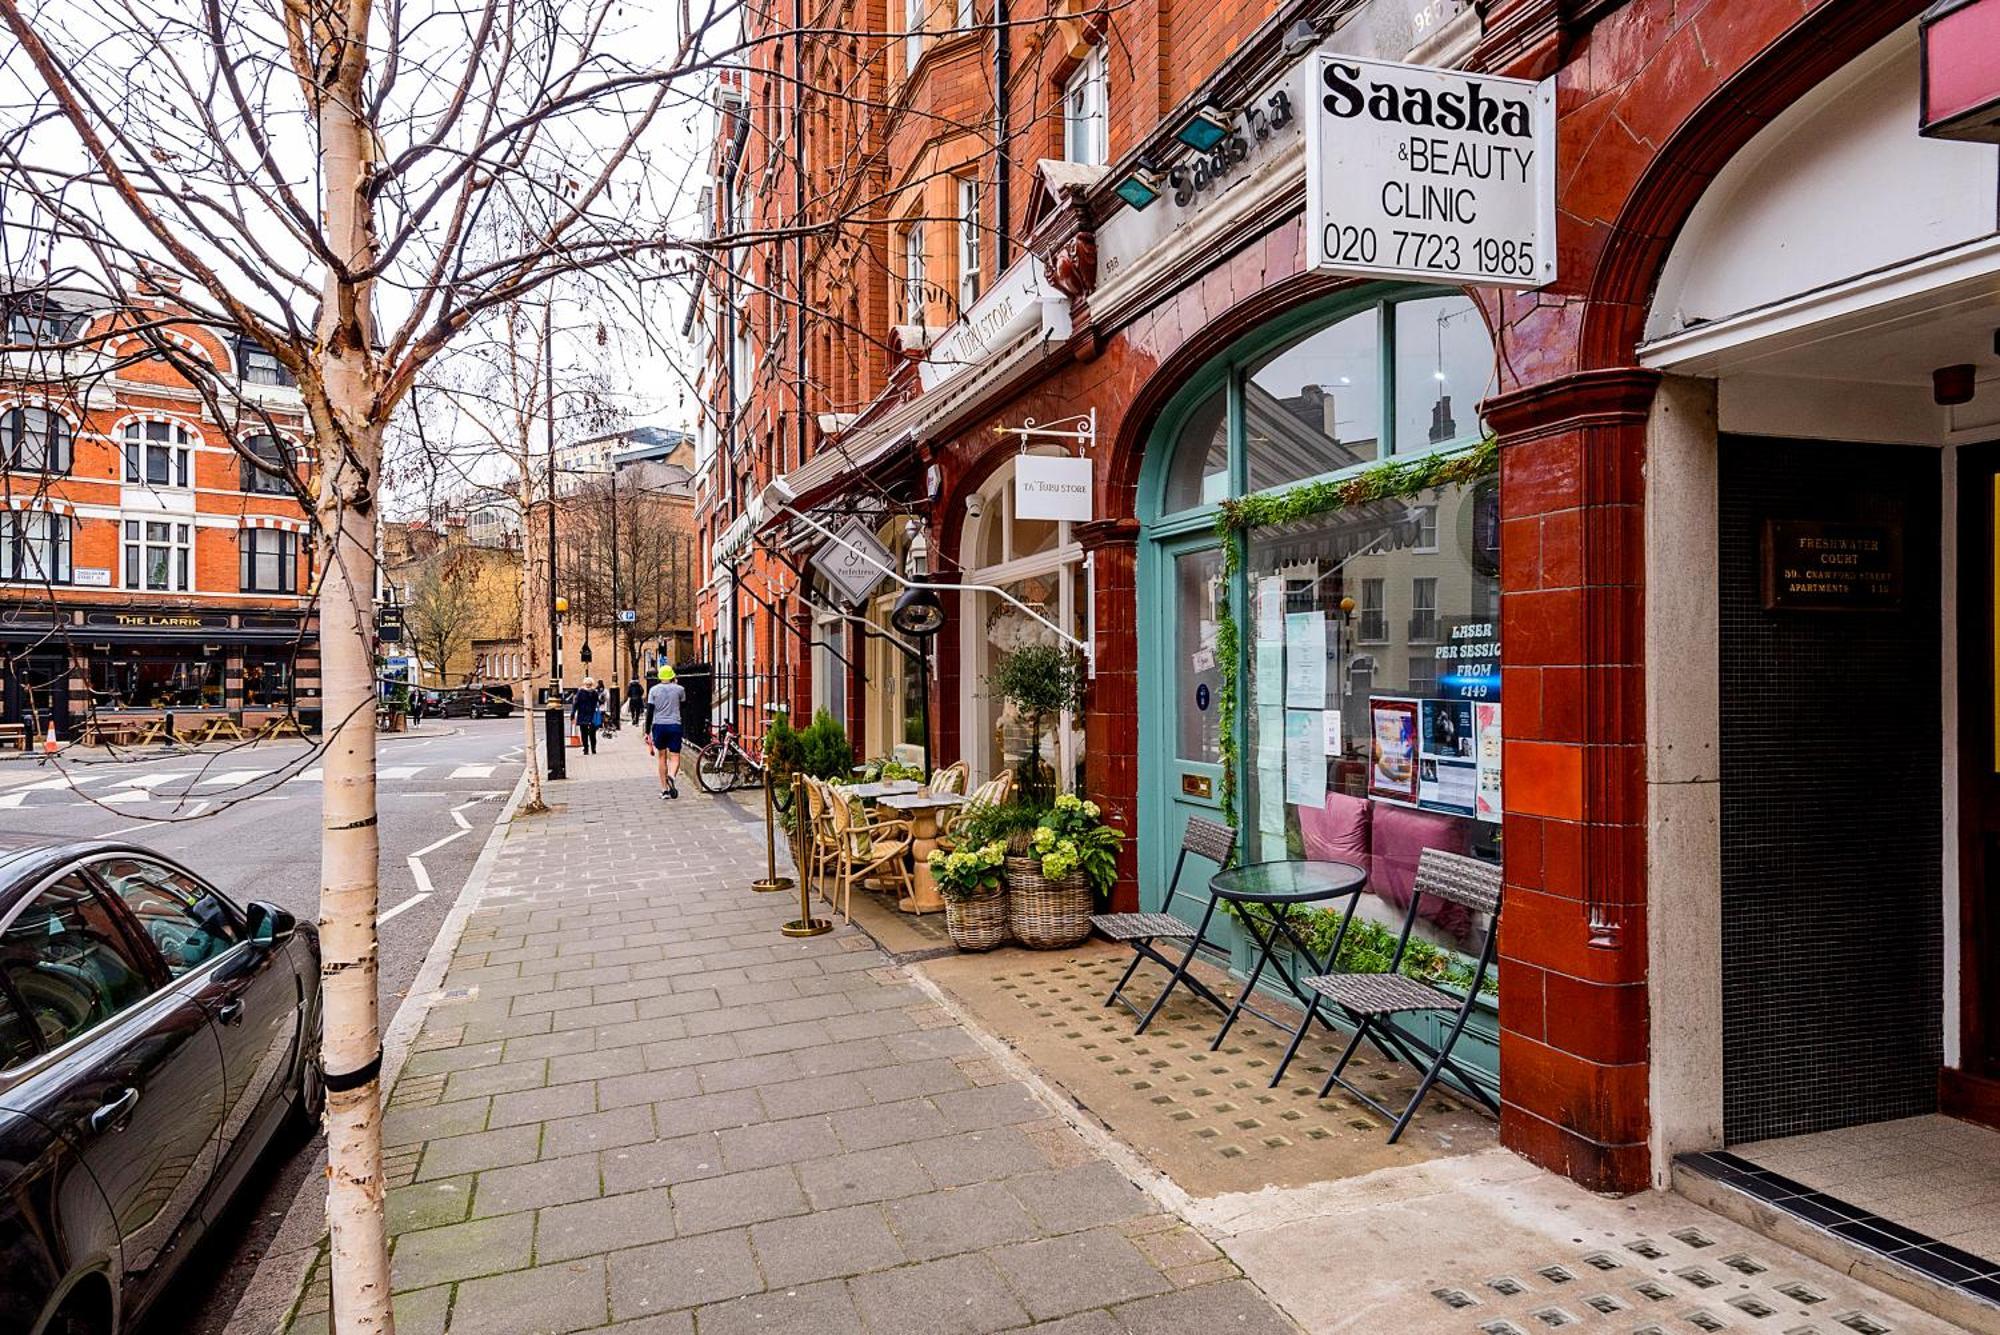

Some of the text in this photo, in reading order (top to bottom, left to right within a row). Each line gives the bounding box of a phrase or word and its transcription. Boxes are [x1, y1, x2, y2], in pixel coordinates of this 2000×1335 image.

[1323, 63, 1532, 138] Saasha
[1382, 181, 1476, 224] CLINIC
[1323, 223, 1534, 276] 020 7723 1985
[982, 296, 1017, 340] STORE
[1061, 482, 1088, 494] STORE
[1820, 554, 1858, 564] COURT
[149, 616, 202, 627] LARRIK
[1451, 623, 1492, 639] LASER
[1435, 646, 1458, 660] PER
[1457, 664, 1492, 678] FROM
[1461, 686, 1488, 698] £149
